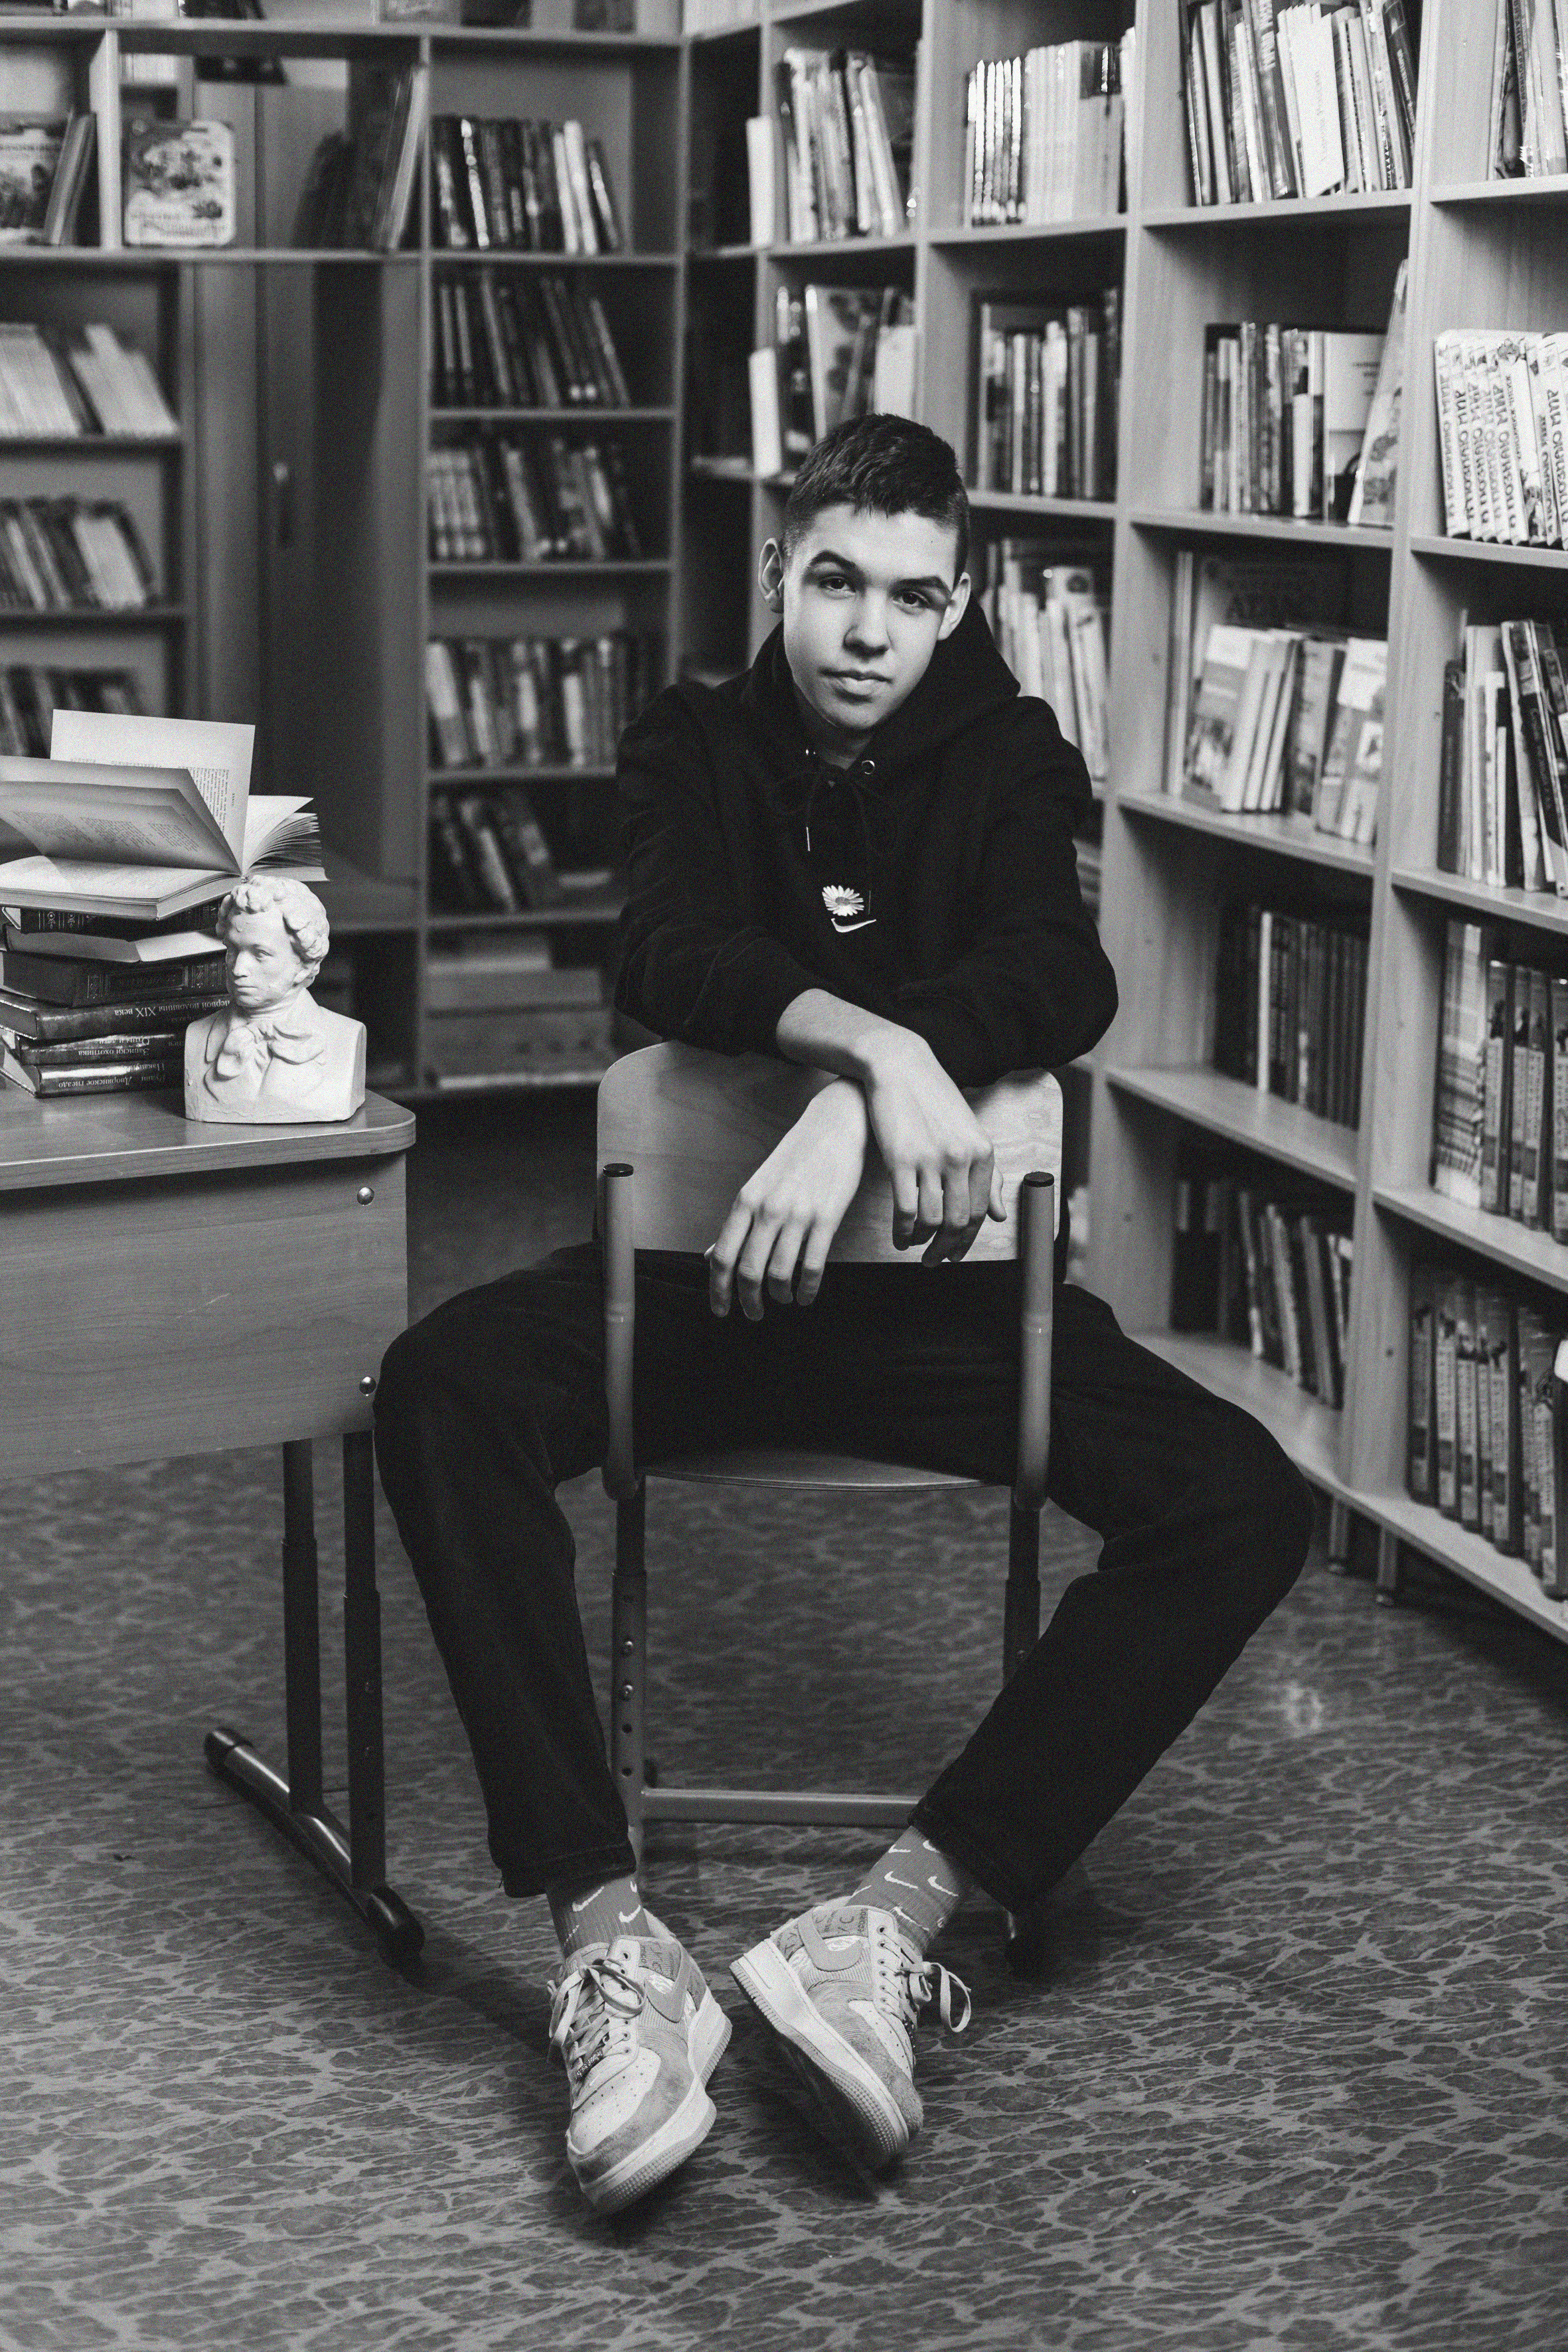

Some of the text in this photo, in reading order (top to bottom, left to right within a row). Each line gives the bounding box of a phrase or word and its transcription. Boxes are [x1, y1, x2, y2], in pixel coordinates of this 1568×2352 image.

[1454, 390, 1466, 425] МИР
[1493, 384, 1508, 426] МИР
[1547, 389, 1561, 427] МИР
[1498, 431, 1515, 510] ПОЗНАЮ
[114, 1008, 133, 1016] века
[135, 1006, 156, 1018] XIX
[58, 1080, 84, 1089] гнездо
[88, 1075, 132, 1086] Дворянское
